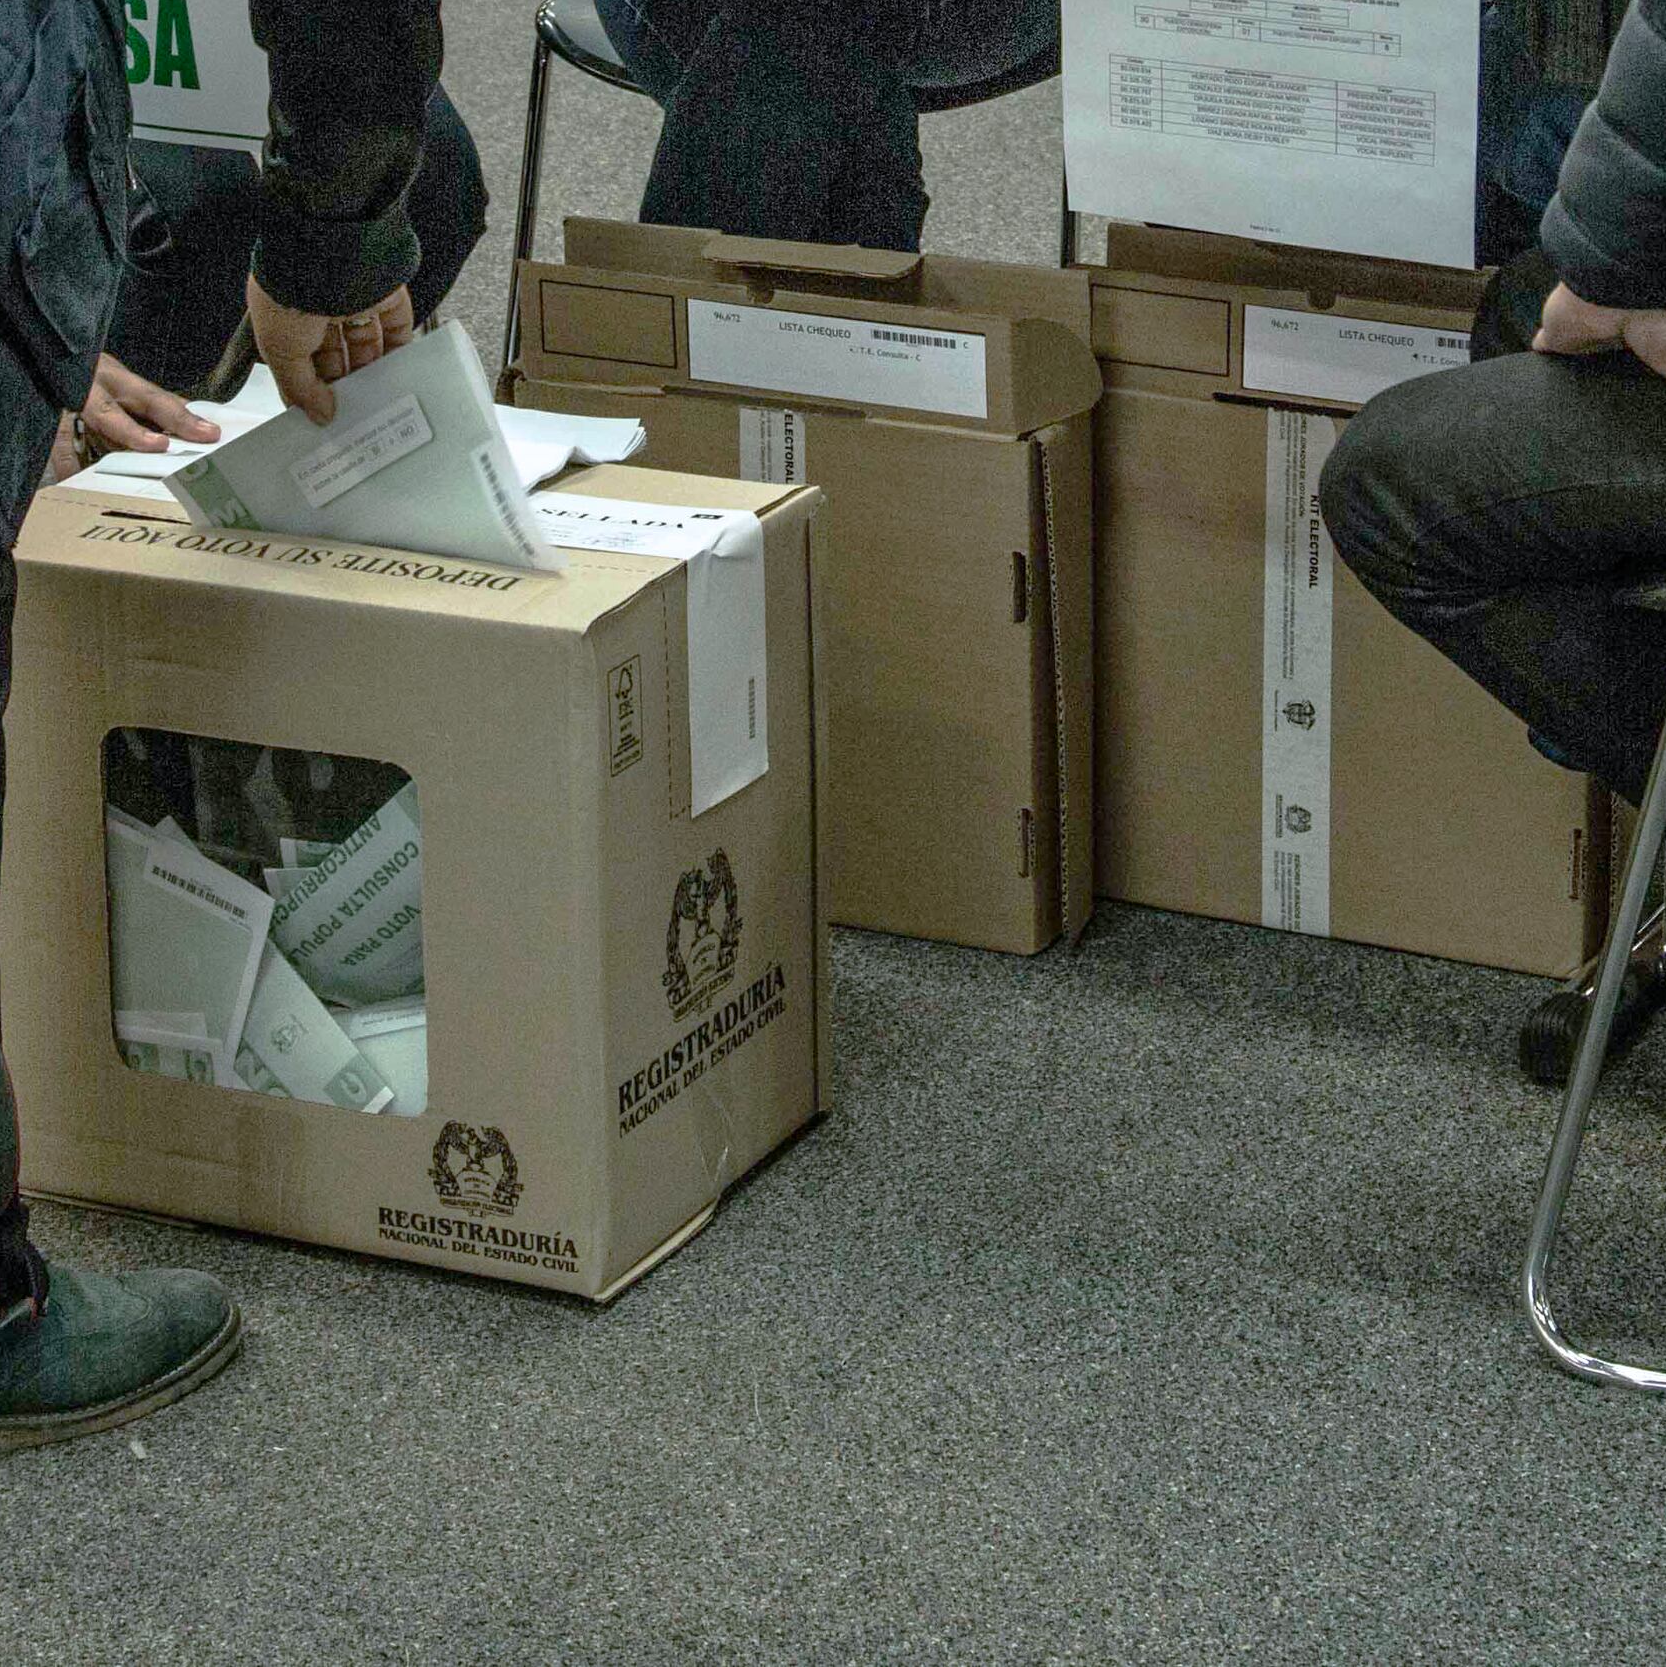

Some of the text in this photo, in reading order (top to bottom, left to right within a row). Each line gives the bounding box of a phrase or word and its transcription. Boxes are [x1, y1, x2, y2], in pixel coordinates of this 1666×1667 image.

[779, 321, 851, 339] LISTA CHEQUEO
[1339, 330, 1415, 347] LISTA CHEQUEO
[784, 414, 794, 484] ELECTORAL
[79, 525, 524, 591] DEPOSITE SU VOTO AQUI
[1308, 494, 1320, 589] KIT ELECTORAL
[284, 840, 419, 966] CONSULTA POPUL
[339, 903, 420, 968] VOTO PARA
[618, 960, 785, 1115] REGISTRADURÍA
[618, 1000, 786, 1138] NACIONAL DEL ESTADO CIVIL
[378, 1206, 579, 1259] REGISTRADURÍA
[379, 1227, 579, 1273] NACIONAL DEL ESTADO CIVIL
